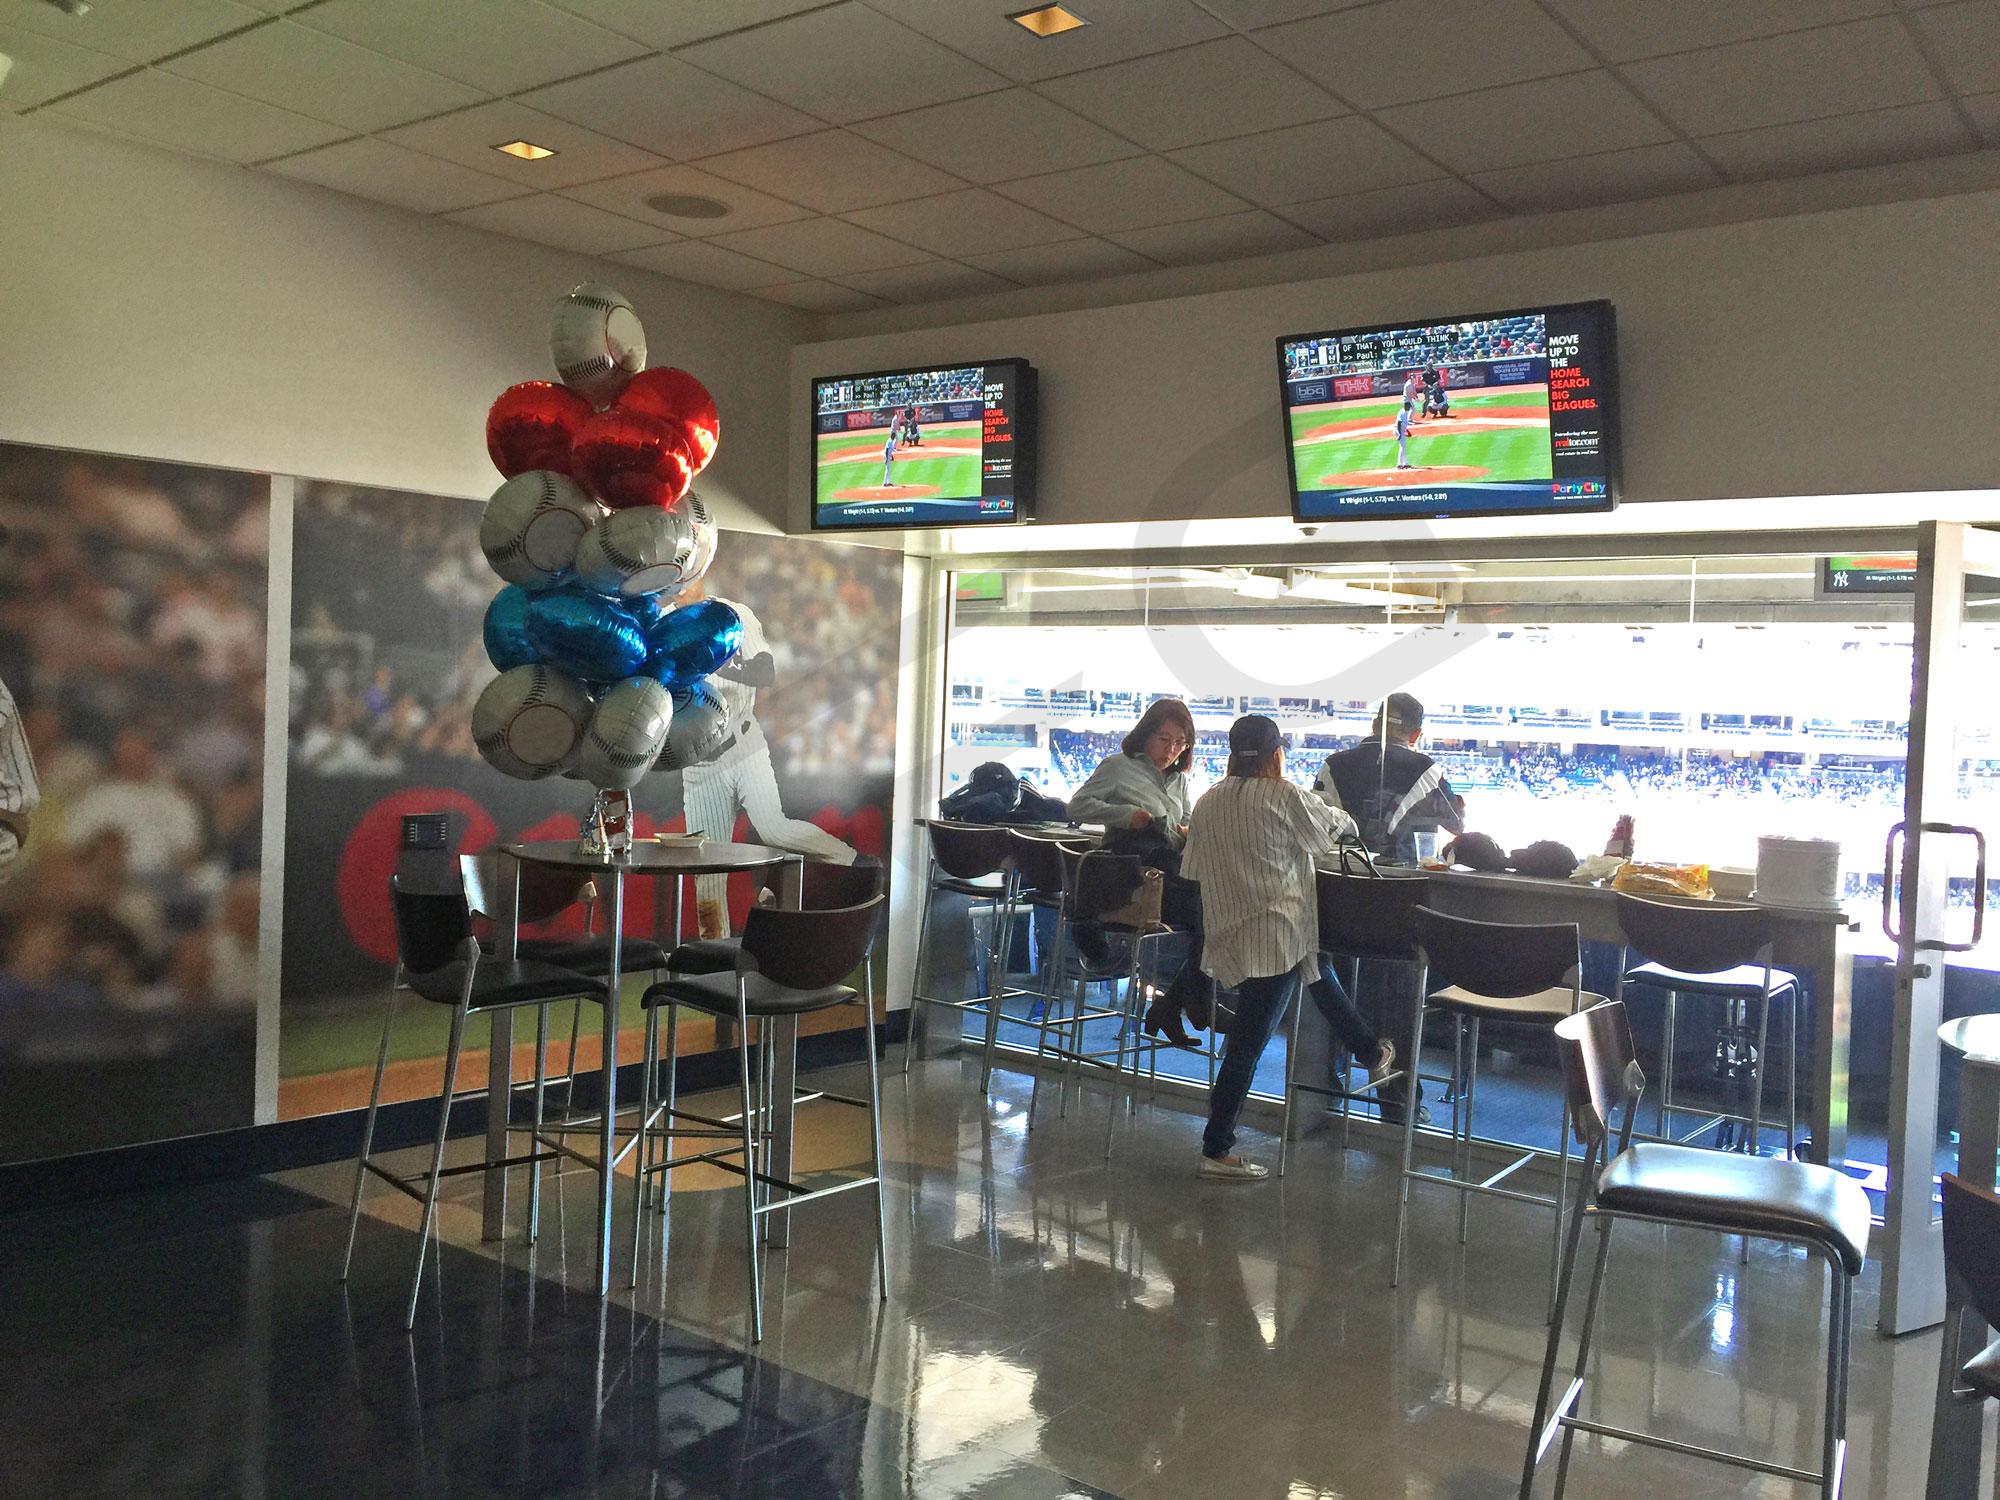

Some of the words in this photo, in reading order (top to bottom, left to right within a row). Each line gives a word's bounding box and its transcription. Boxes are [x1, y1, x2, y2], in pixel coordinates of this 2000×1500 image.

[1342, 344, 1352, 352] OF
[1356, 342, 1377, 350] THAT,
[1382, 340, 1396, 348] YOU
[1399, 336, 1423, 346] WOULD
[1426, 334, 1453, 343] THINK.
[1548, 334, 1580, 346] MOVE
[1356, 351, 1378, 360] Paul:
[1549, 348, 1563, 357] UP
[1564, 346, 1579, 356] TO
[1550, 357, 1568, 368] THE
[1550, 367, 1582, 379] HOME
[984, 383, 1004, 392] MOVE
[1551, 378, 1590, 389] SEARCH
[994, 392, 1003, 400] TO
[1551, 391, 1569, 400] BIG
[984, 401, 996, 409] THE
[1552, 399, 1599, 411] LEAGUES.
[984, 409, 1004, 417] HOME
